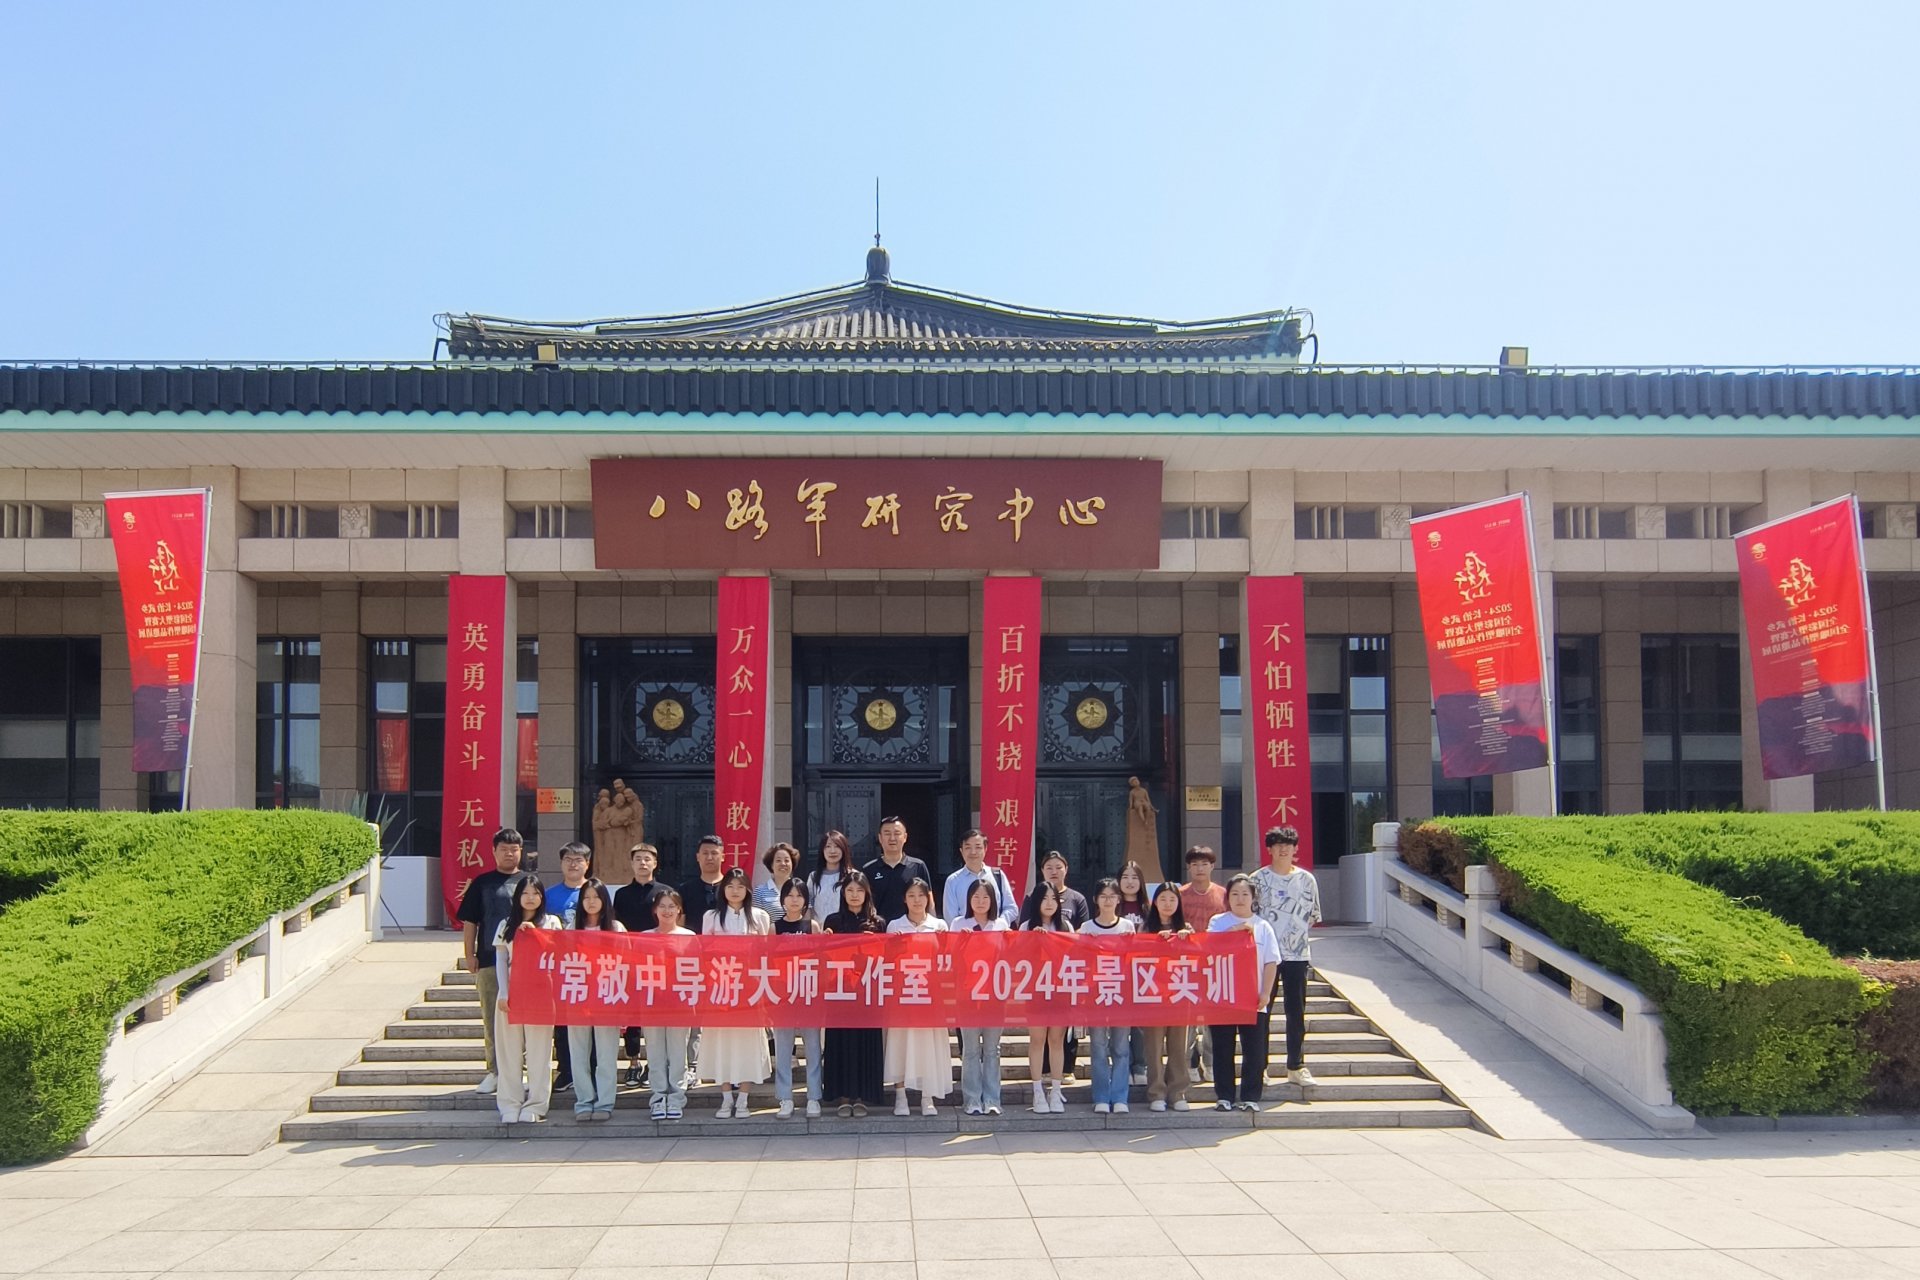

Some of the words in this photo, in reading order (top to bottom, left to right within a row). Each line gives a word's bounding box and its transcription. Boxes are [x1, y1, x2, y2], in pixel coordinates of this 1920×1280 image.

[459, 622, 488, 771] 英勇奋斗
[728, 625, 755, 769] 万众一心
[996, 625, 1025, 772] 百折不挠
[1262, 622, 1296, 768] 不怕牺牲
[725, 801, 751, 868] 敢于
[971, 953, 1235, 1006] 2024年景区实训
